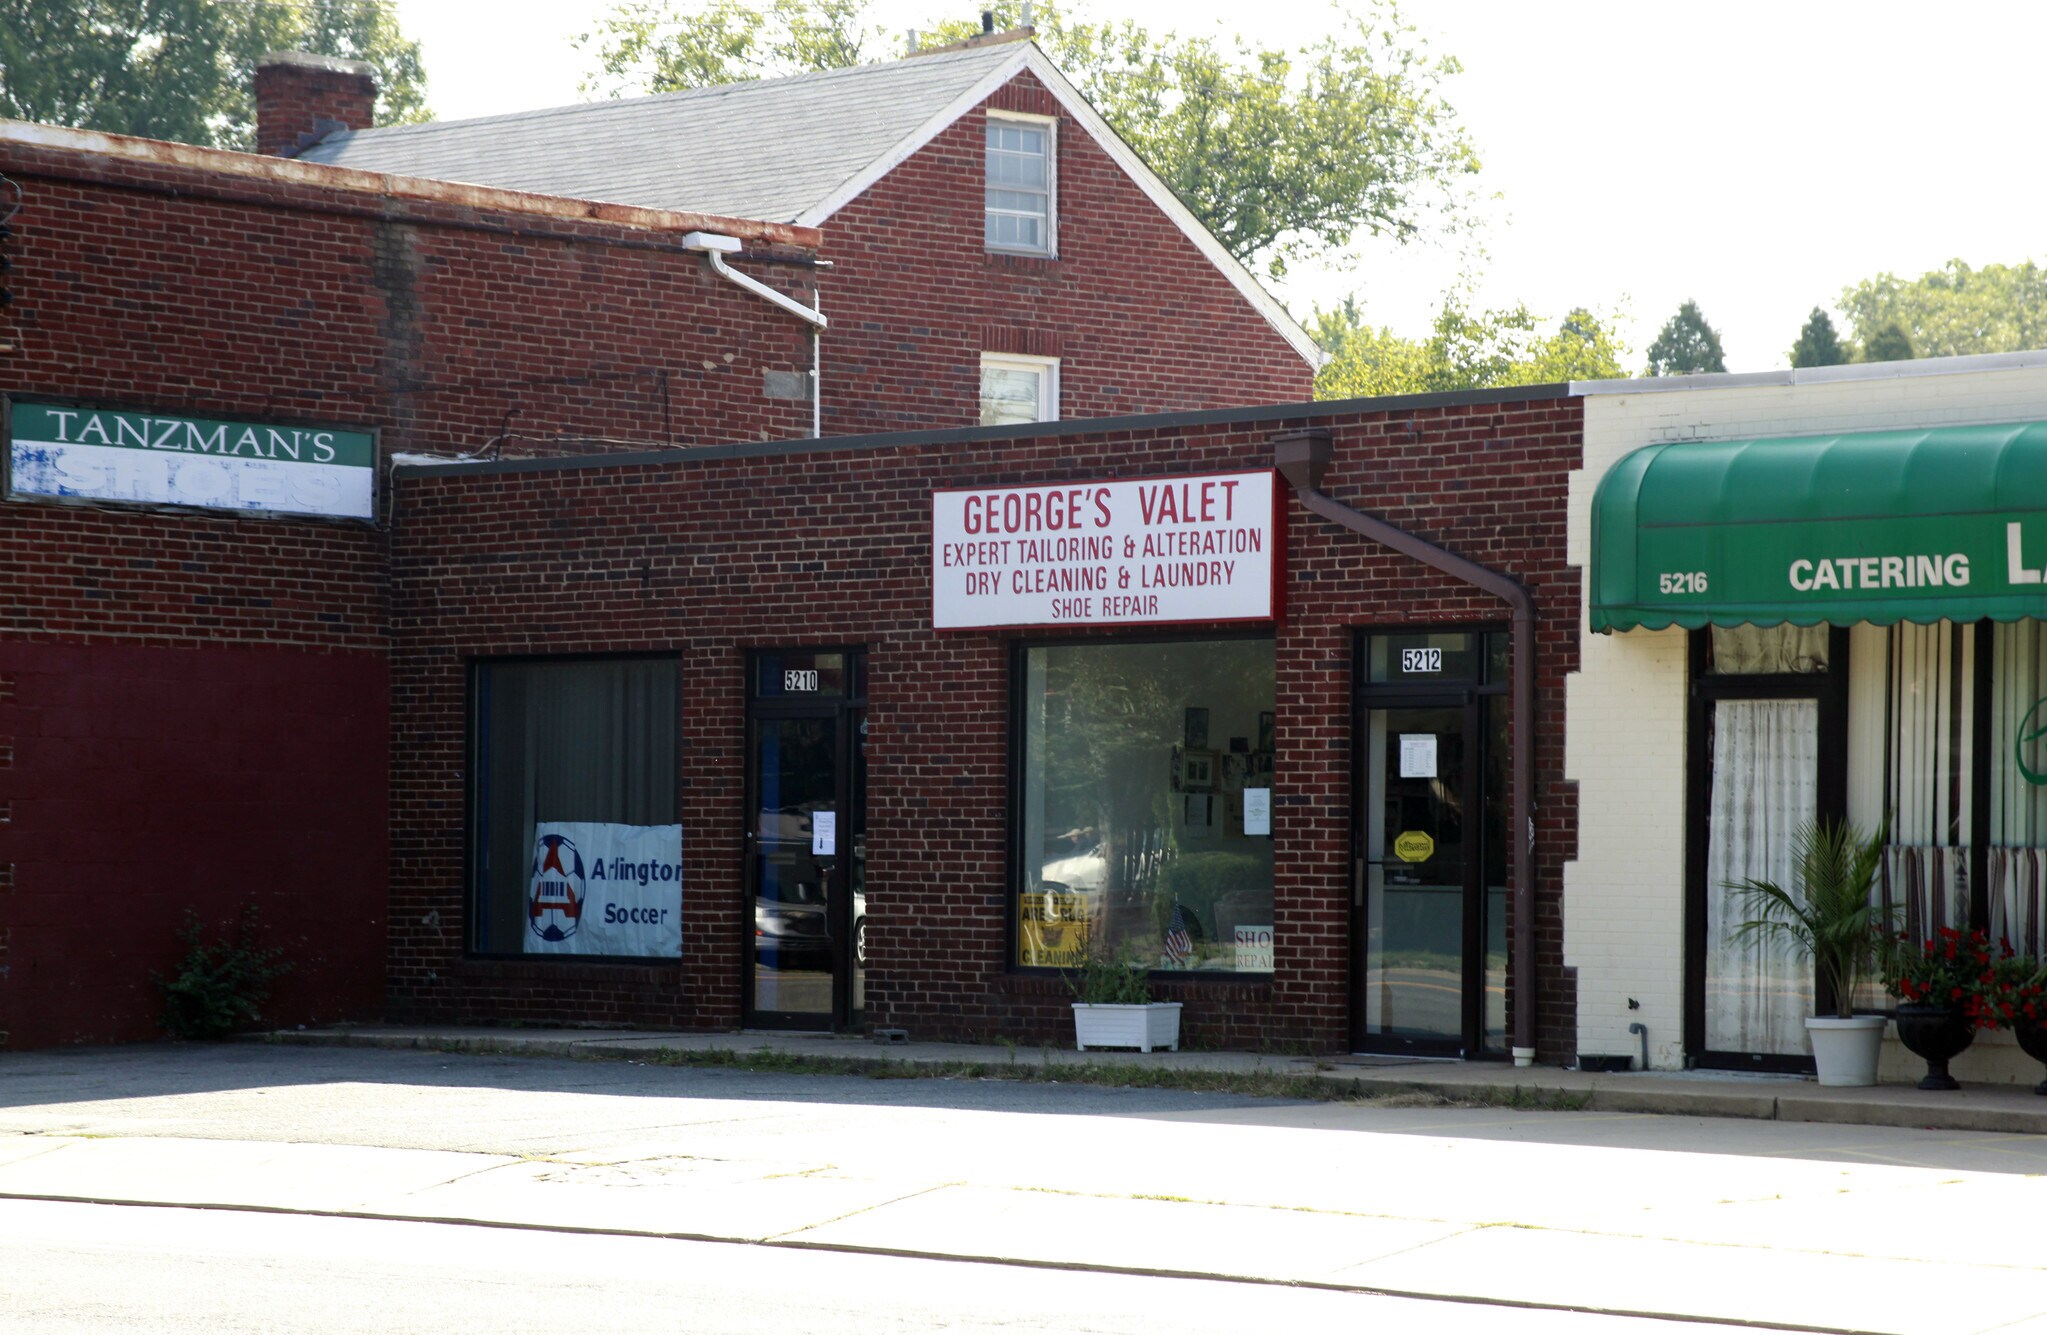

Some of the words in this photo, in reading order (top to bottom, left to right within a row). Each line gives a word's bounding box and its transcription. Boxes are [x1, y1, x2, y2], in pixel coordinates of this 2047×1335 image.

[46, 410, 335, 463] TANZMAN'S
[964, 487, 1112, 534] GEORGE'S
[1139, 480, 1239, 525] VALET
[943, 540, 1012, 567] EXPERT
[1017, 535, 1112, 563] TAILORING
[1123, 535, 1136, 558] &
[1142, 528, 1262, 557] ALTERATION
[2008, 522, 2047, 585] L
[966, 571, 1002, 595] DRY
[1012, 566, 1108, 594] CLEANING
[1118, 566, 1130, 589] &
[1141, 560, 1235, 588] LAUNDRY
[1659, 572, 1708, 594] 5216
[1789, 554, 1970, 591] CATERING
[1051, 597, 1092, 618] SHOE
[1102, 595, 1158, 616] REPAIR
[1403, 649, 1441, 671] 5212
[786, 671, 816, 690] 5210
[604, 903, 668, 925] Soccer
[1022, 907, 1057, 921] ARE
[1235, 930, 1274, 948] SHO
